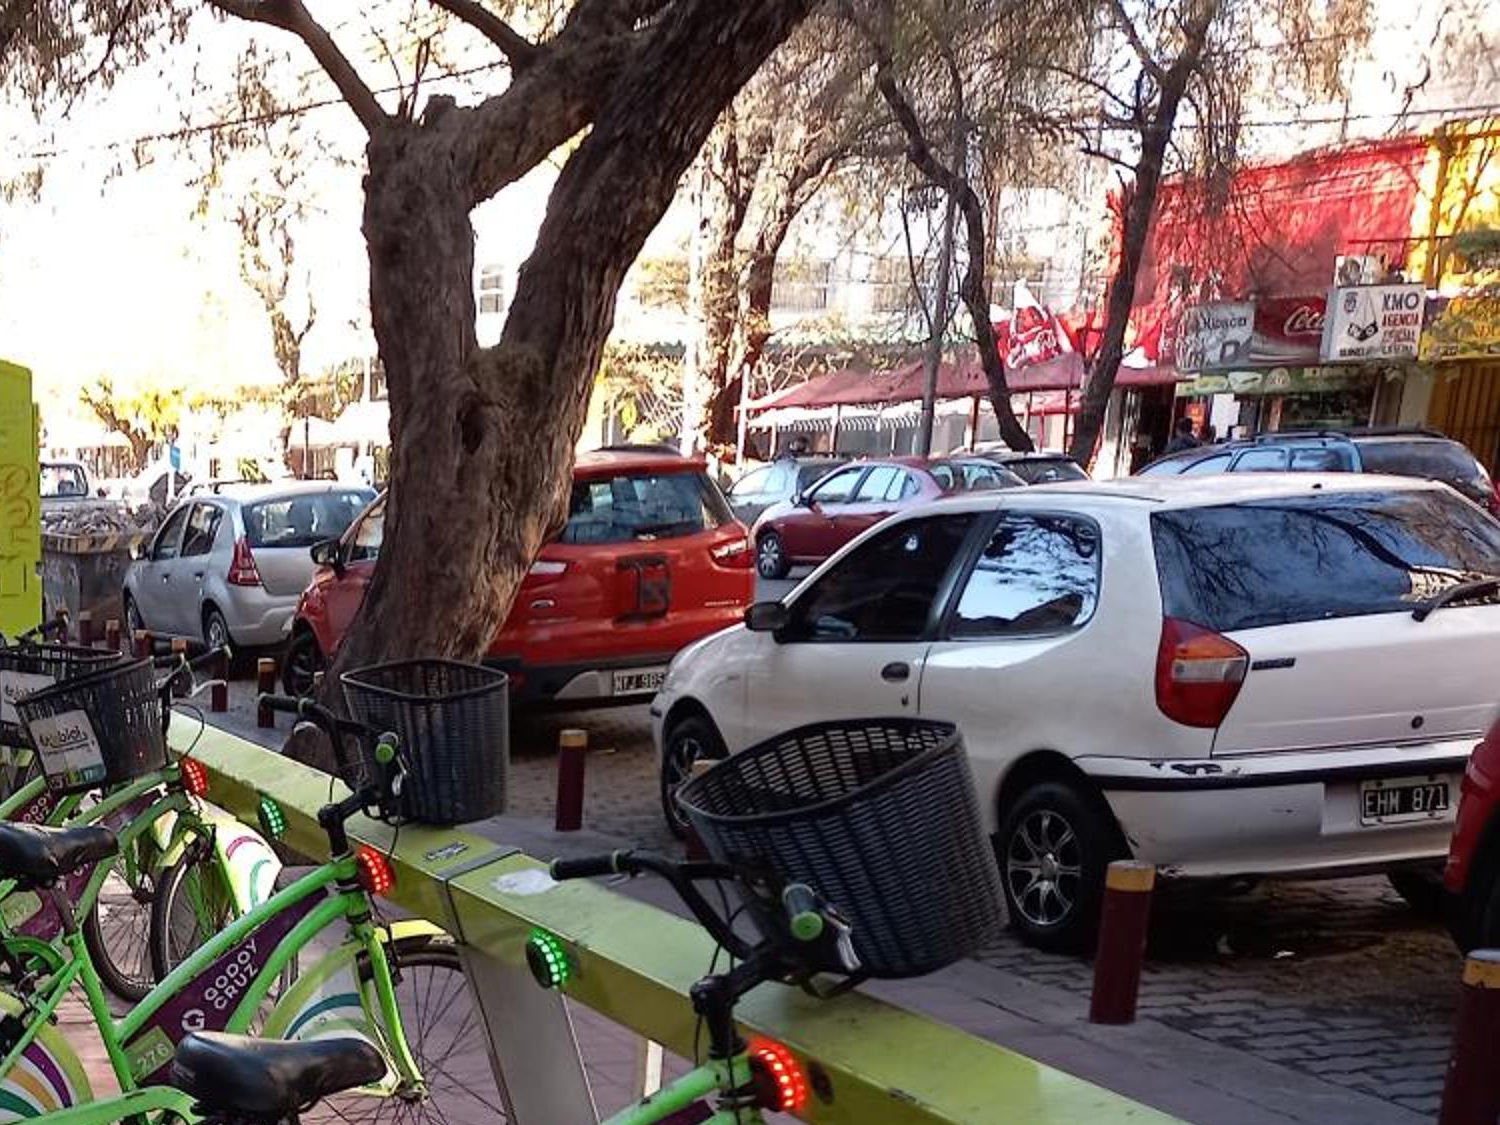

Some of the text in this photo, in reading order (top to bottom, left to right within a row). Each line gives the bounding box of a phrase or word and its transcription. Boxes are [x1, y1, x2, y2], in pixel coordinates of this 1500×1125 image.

[1411, 785, 1447, 811] 871
[204, 938, 257, 1001] GODOY
[214, 964, 258, 1010] CRUZ
